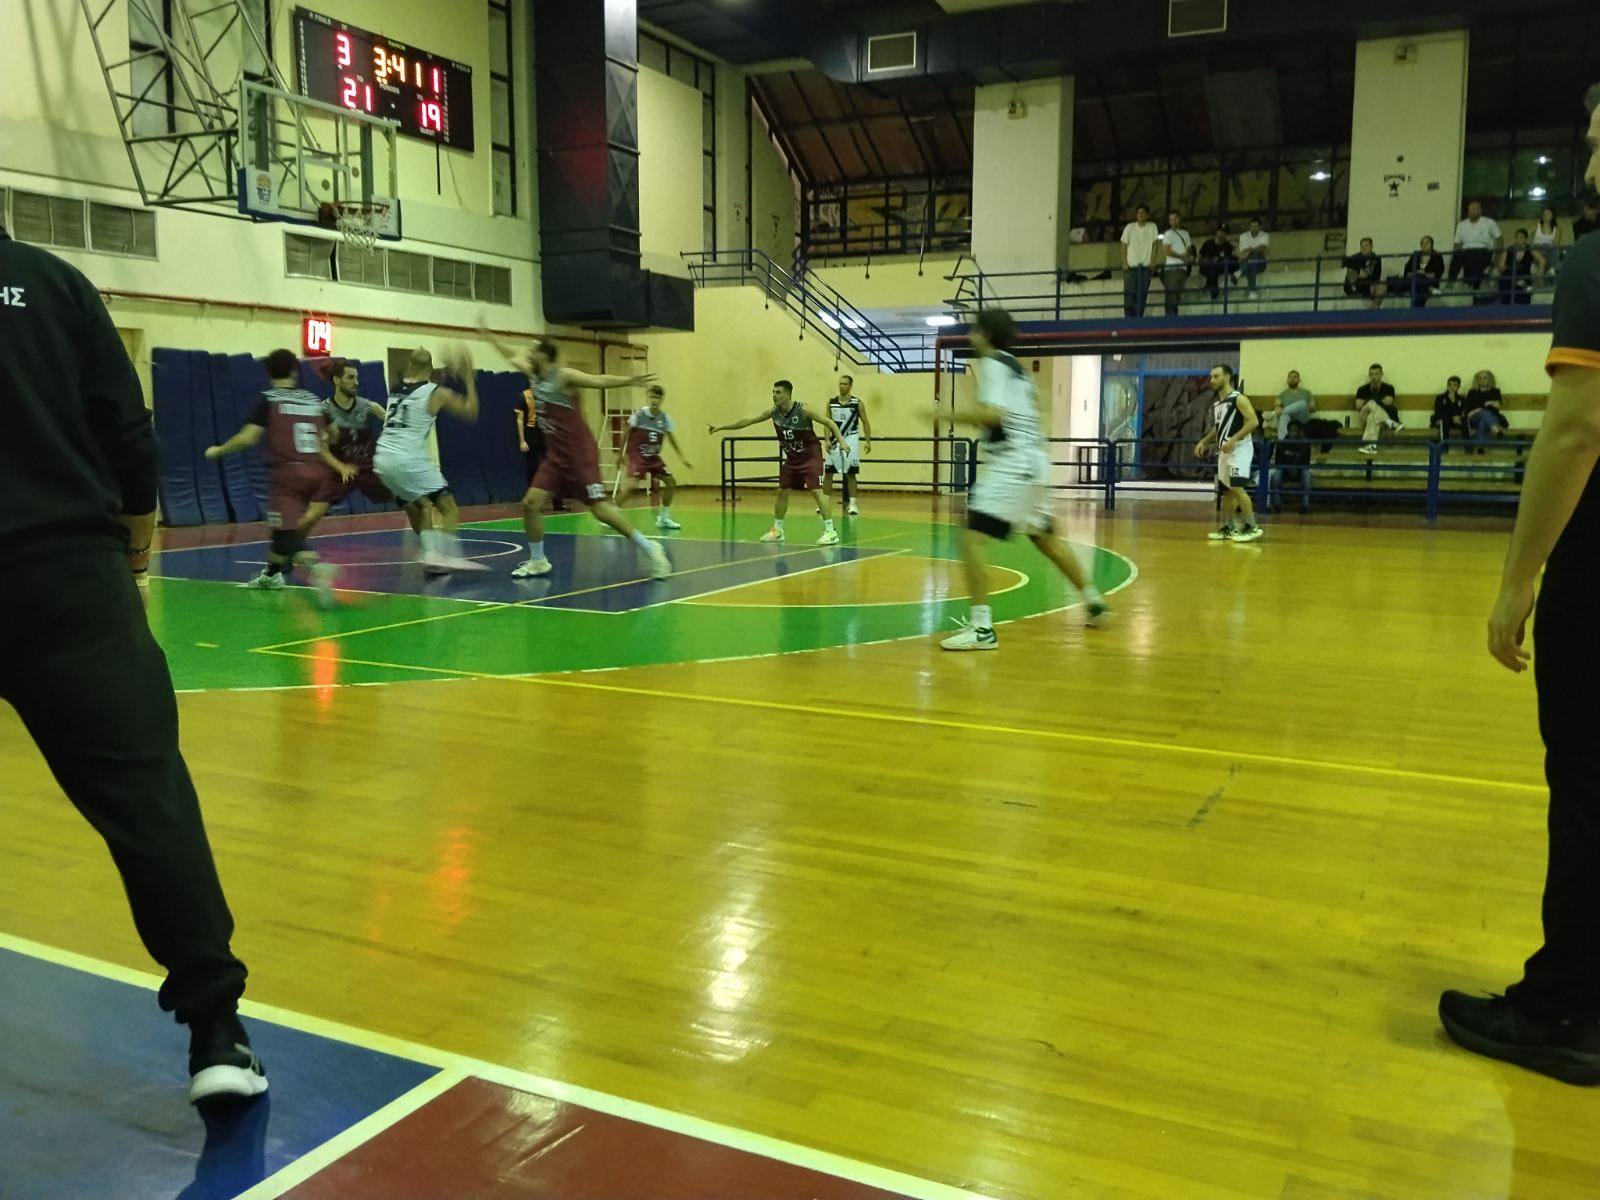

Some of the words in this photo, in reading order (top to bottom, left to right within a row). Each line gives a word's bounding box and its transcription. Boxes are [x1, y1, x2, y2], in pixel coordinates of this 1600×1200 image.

[337, 34, 351, 66] 3
[343, 76, 373, 112] 21
[433, 68, 440, 94] 1
[421, 102, 441, 131] 19
[308, 319, 331, 351] 04
[293, 422, 321, 454] 6
[782, 428, 795, 441] 15
